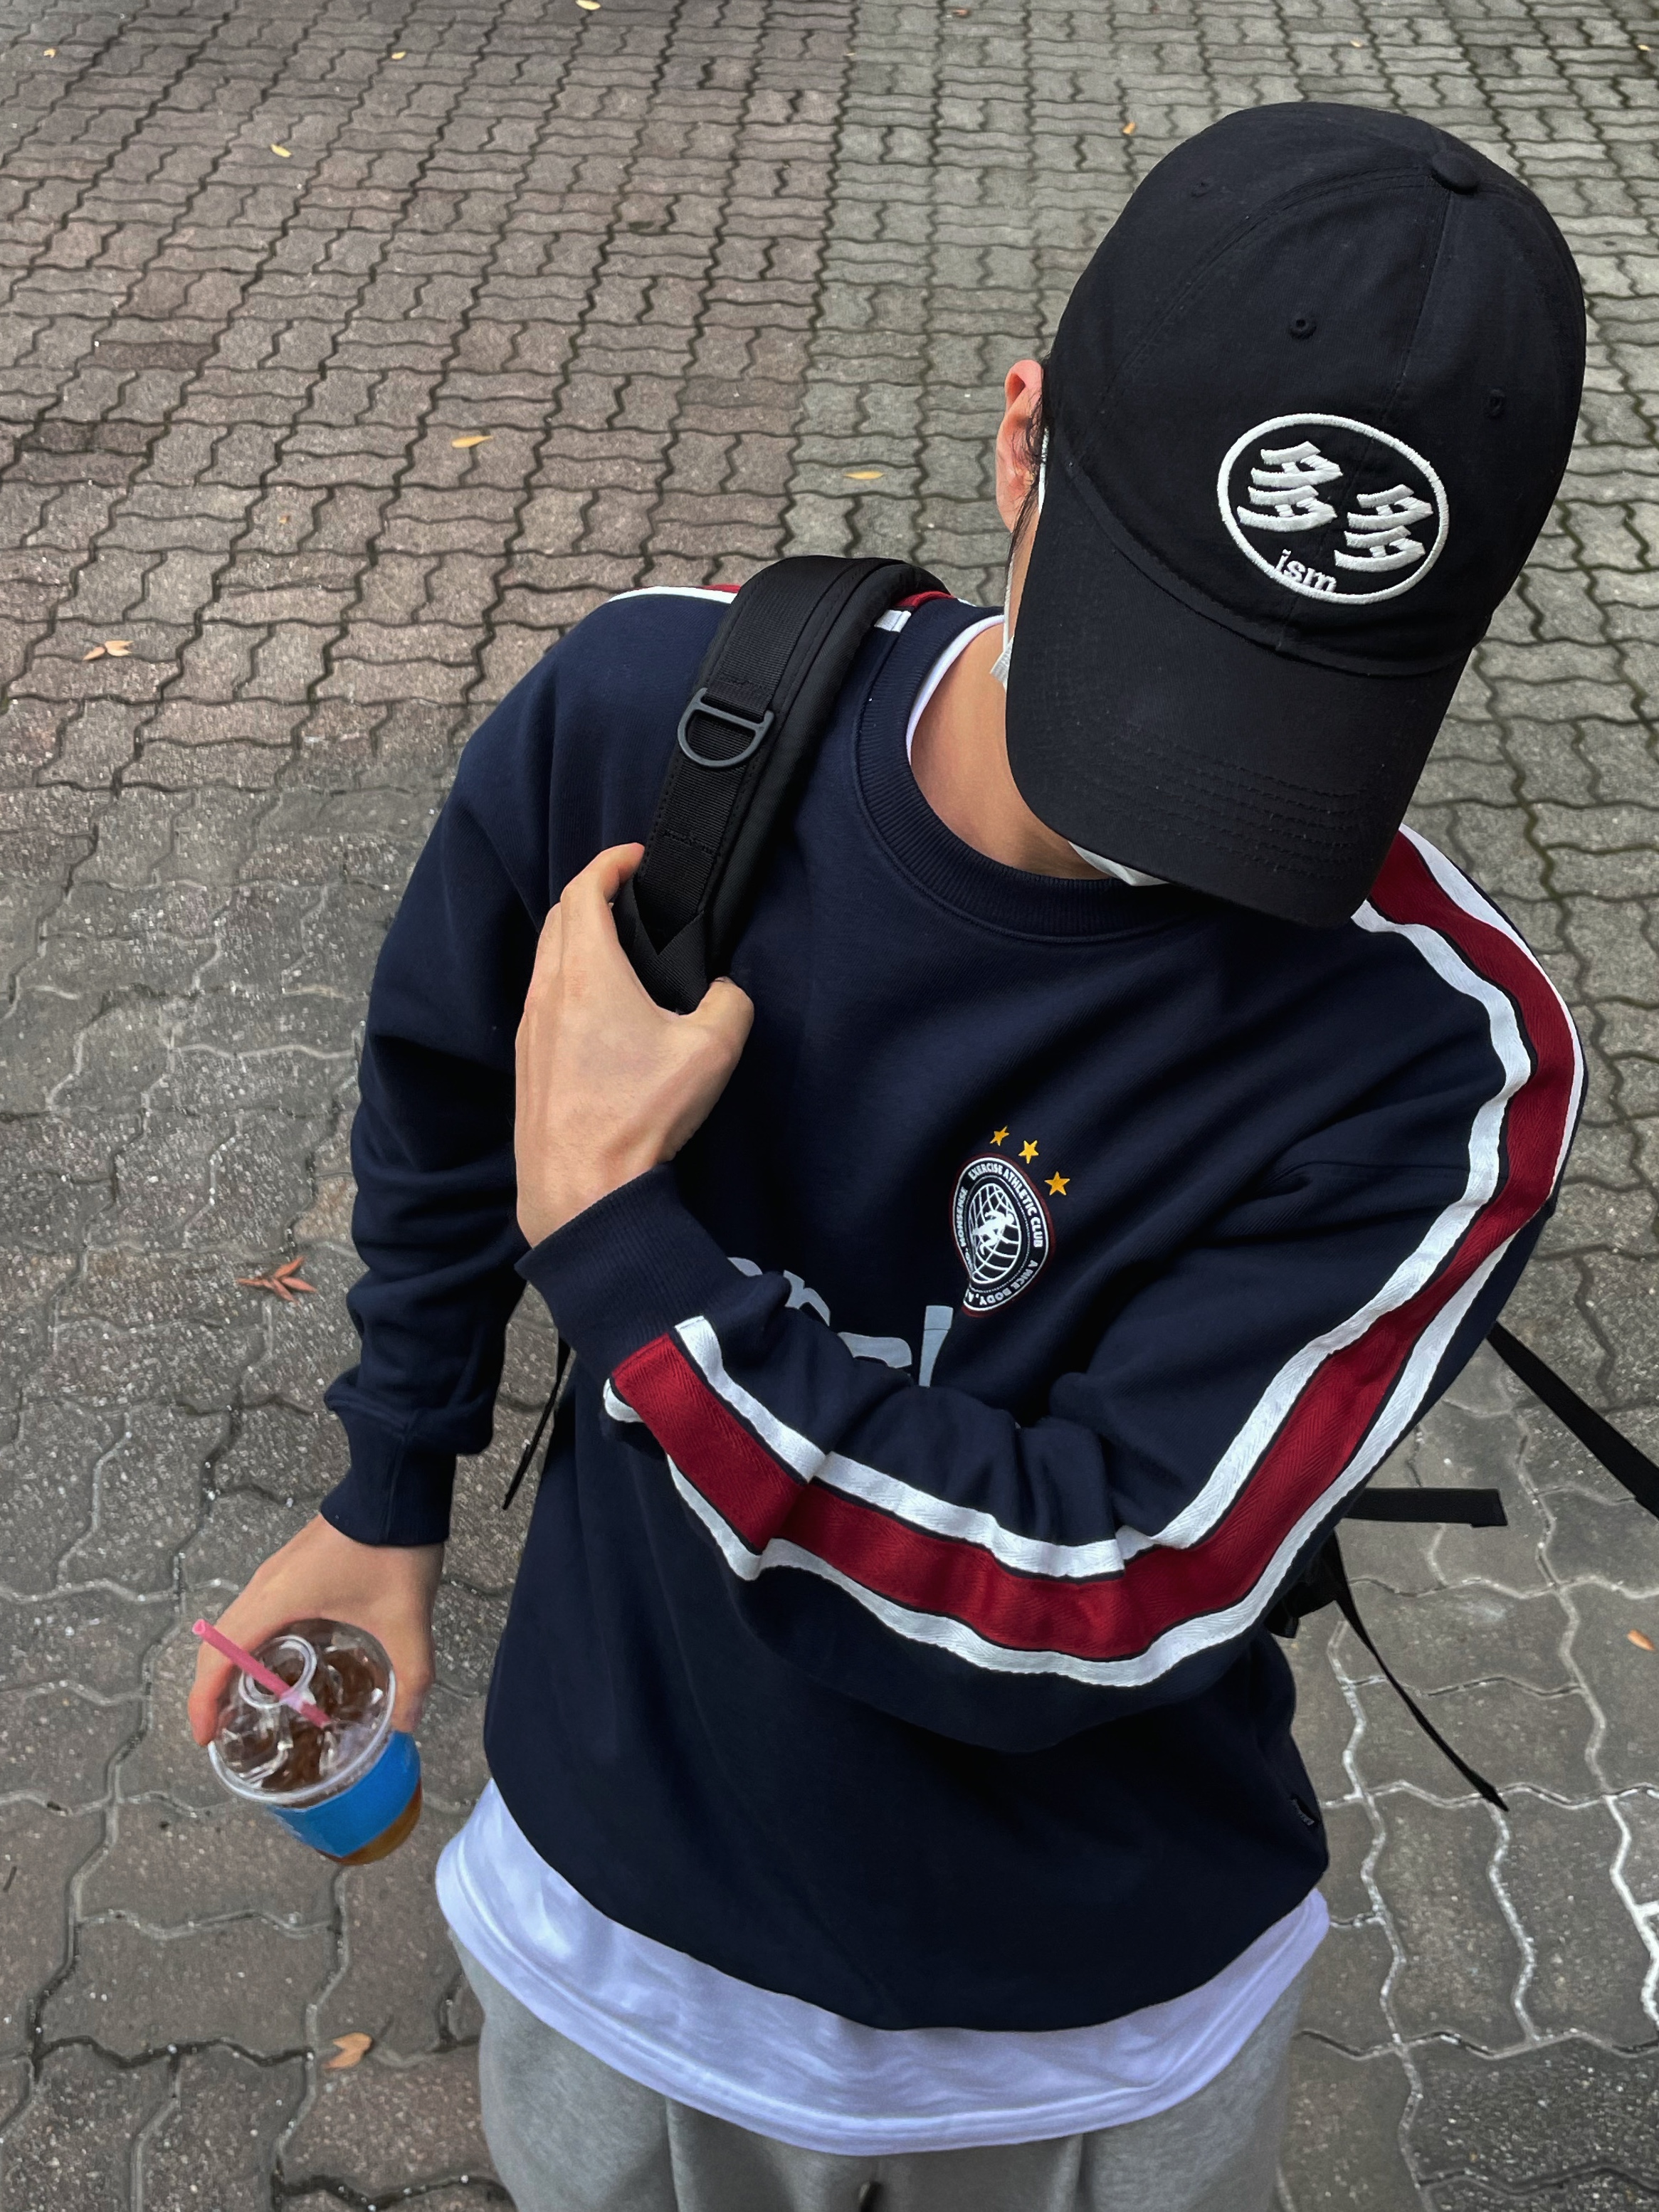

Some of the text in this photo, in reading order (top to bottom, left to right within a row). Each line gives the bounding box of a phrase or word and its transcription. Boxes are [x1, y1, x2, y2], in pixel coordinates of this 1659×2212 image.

[1275, 549, 1337, 593] ism
[956, 1186, 968, 1247] NONSENSE
[968, 1162, 1043, 1248] EXERCISE ATHLETIC CLUB
